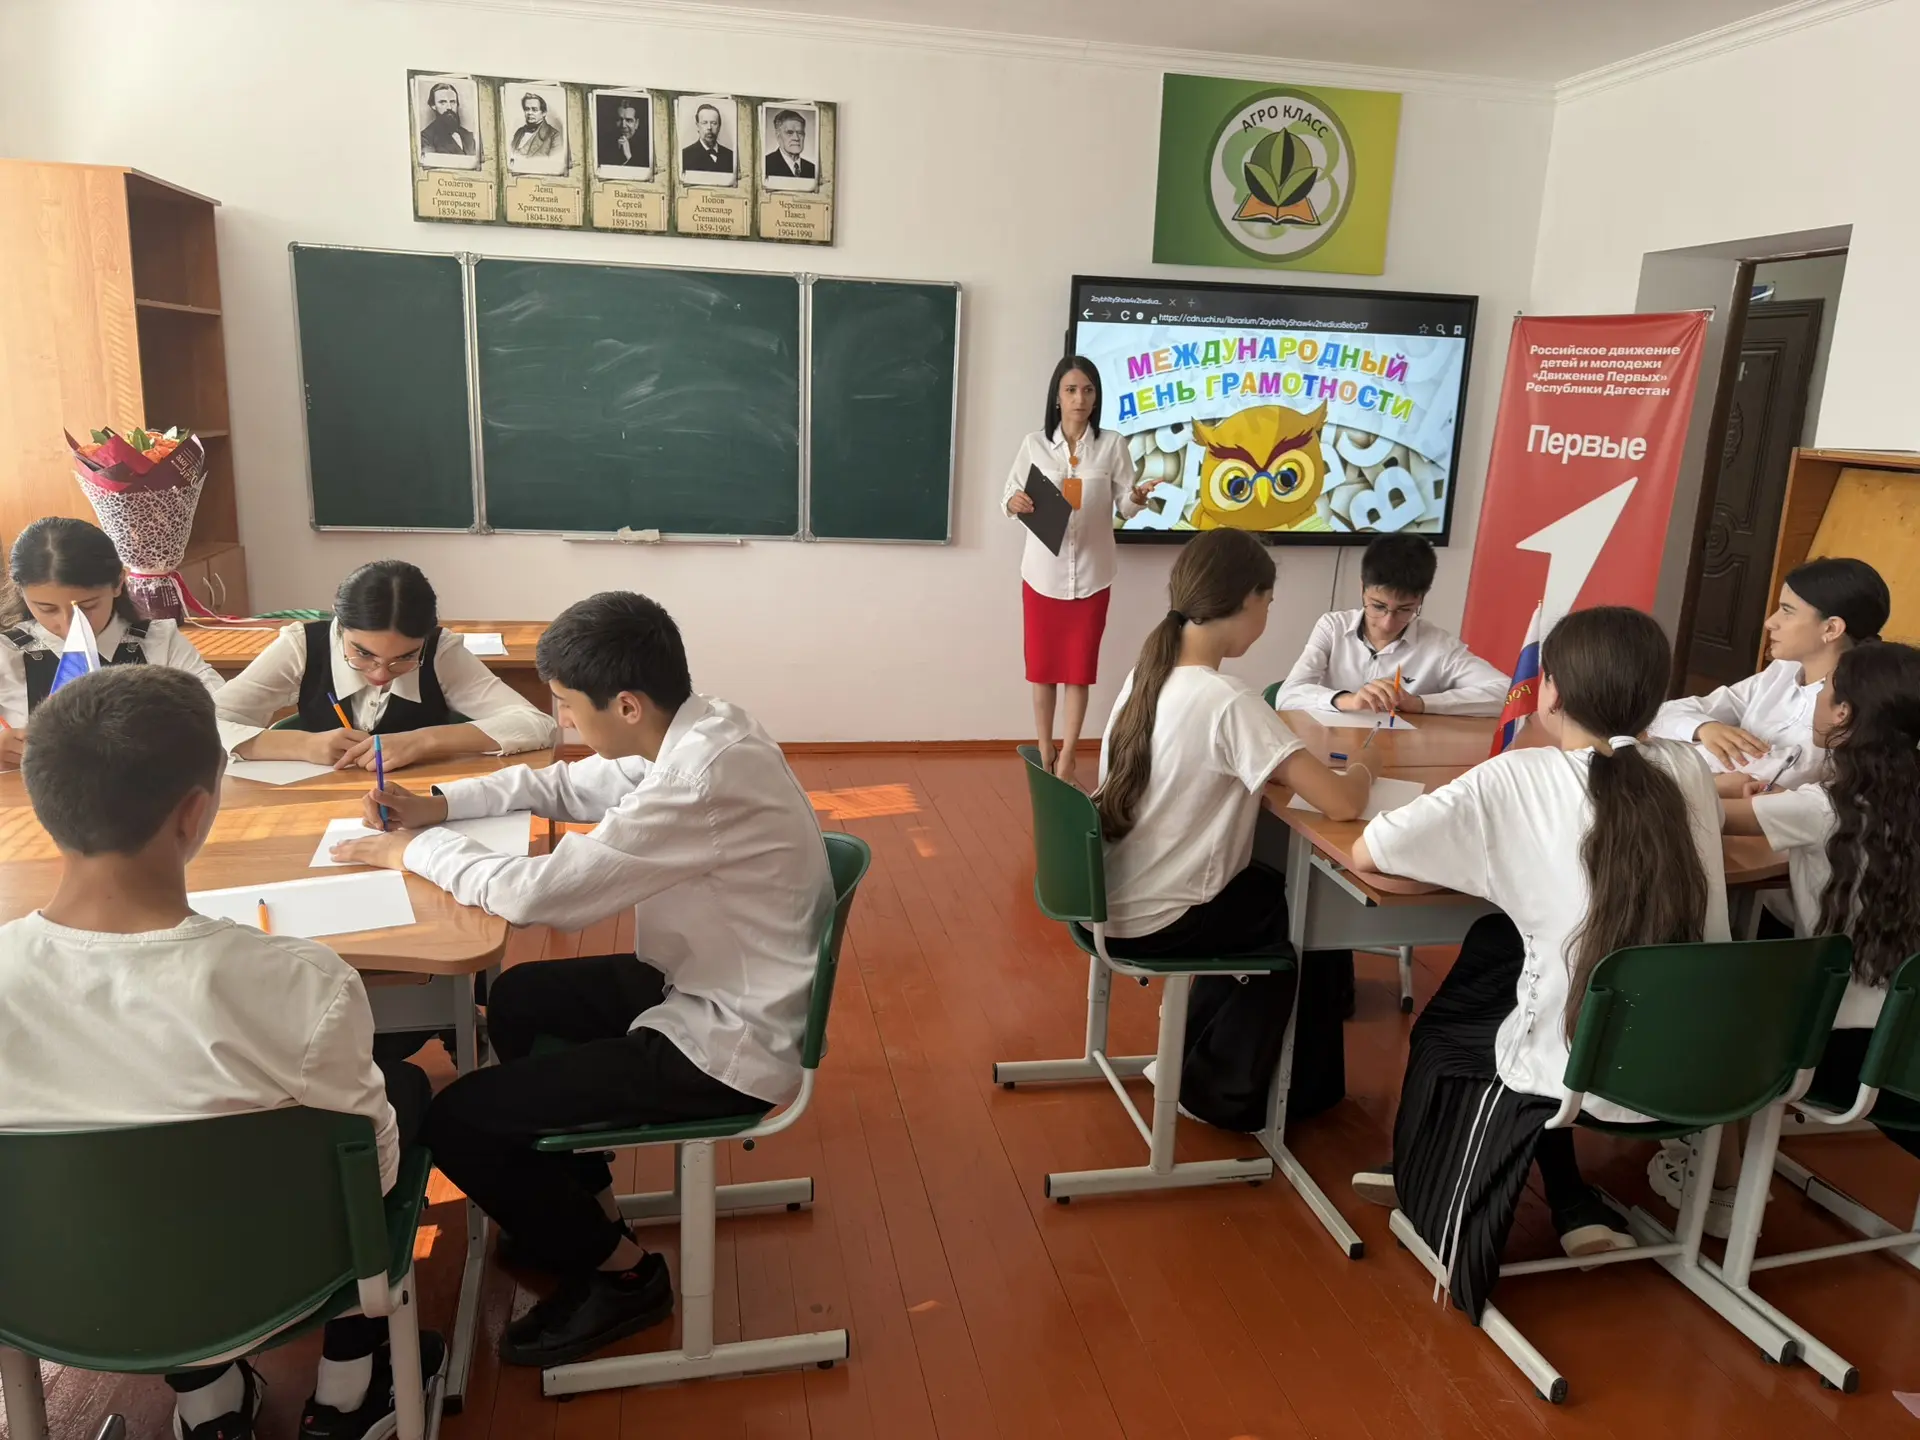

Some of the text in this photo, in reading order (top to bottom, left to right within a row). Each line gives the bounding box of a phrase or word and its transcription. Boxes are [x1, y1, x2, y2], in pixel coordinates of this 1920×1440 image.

[1241, 104, 1329, 138] АГРО КЛАСС
[437, 178, 473, 189] Столетов
[435, 188, 477, 200] Александр
[533, 185, 554, 195] Ленц
[614, 190, 645, 200] Вавилов
[432, 197, 481, 209] Григорьевич
[529, 194, 559, 204] Эмилий
[701, 196, 725, 205] Попов
[517, 203, 571, 214] Христианович
[616, 200, 642, 210] Сергей
[694, 205, 733, 215] Александр
[438, 207, 476, 218] 1839-1896
[526, 213, 563, 222] 1804-1865
[612, 209, 648, 219] Иванович
[612, 218, 648, 228] 1891-1951
[692, 213, 735, 224] Степанович
[696, 223, 732, 233] 1859-1905
[777, 228, 813, 238] 1904-1990
[1529, 345, 1681, 356] Российское движение
[1127, 336, 1409, 383] МЕЖДУНАРОДНЫЙ
[1540, 357, 1662, 370] детей и молодежи
[1532, 370, 1668, 383] «Движение Первых»
[1525, 382, 1671, 396] Республики Дагестан
[1118, 371, 1414, 423] ДЕНЬ ГРАМОТНОСТИ
[1526, 424, 1647, 464] Первые
